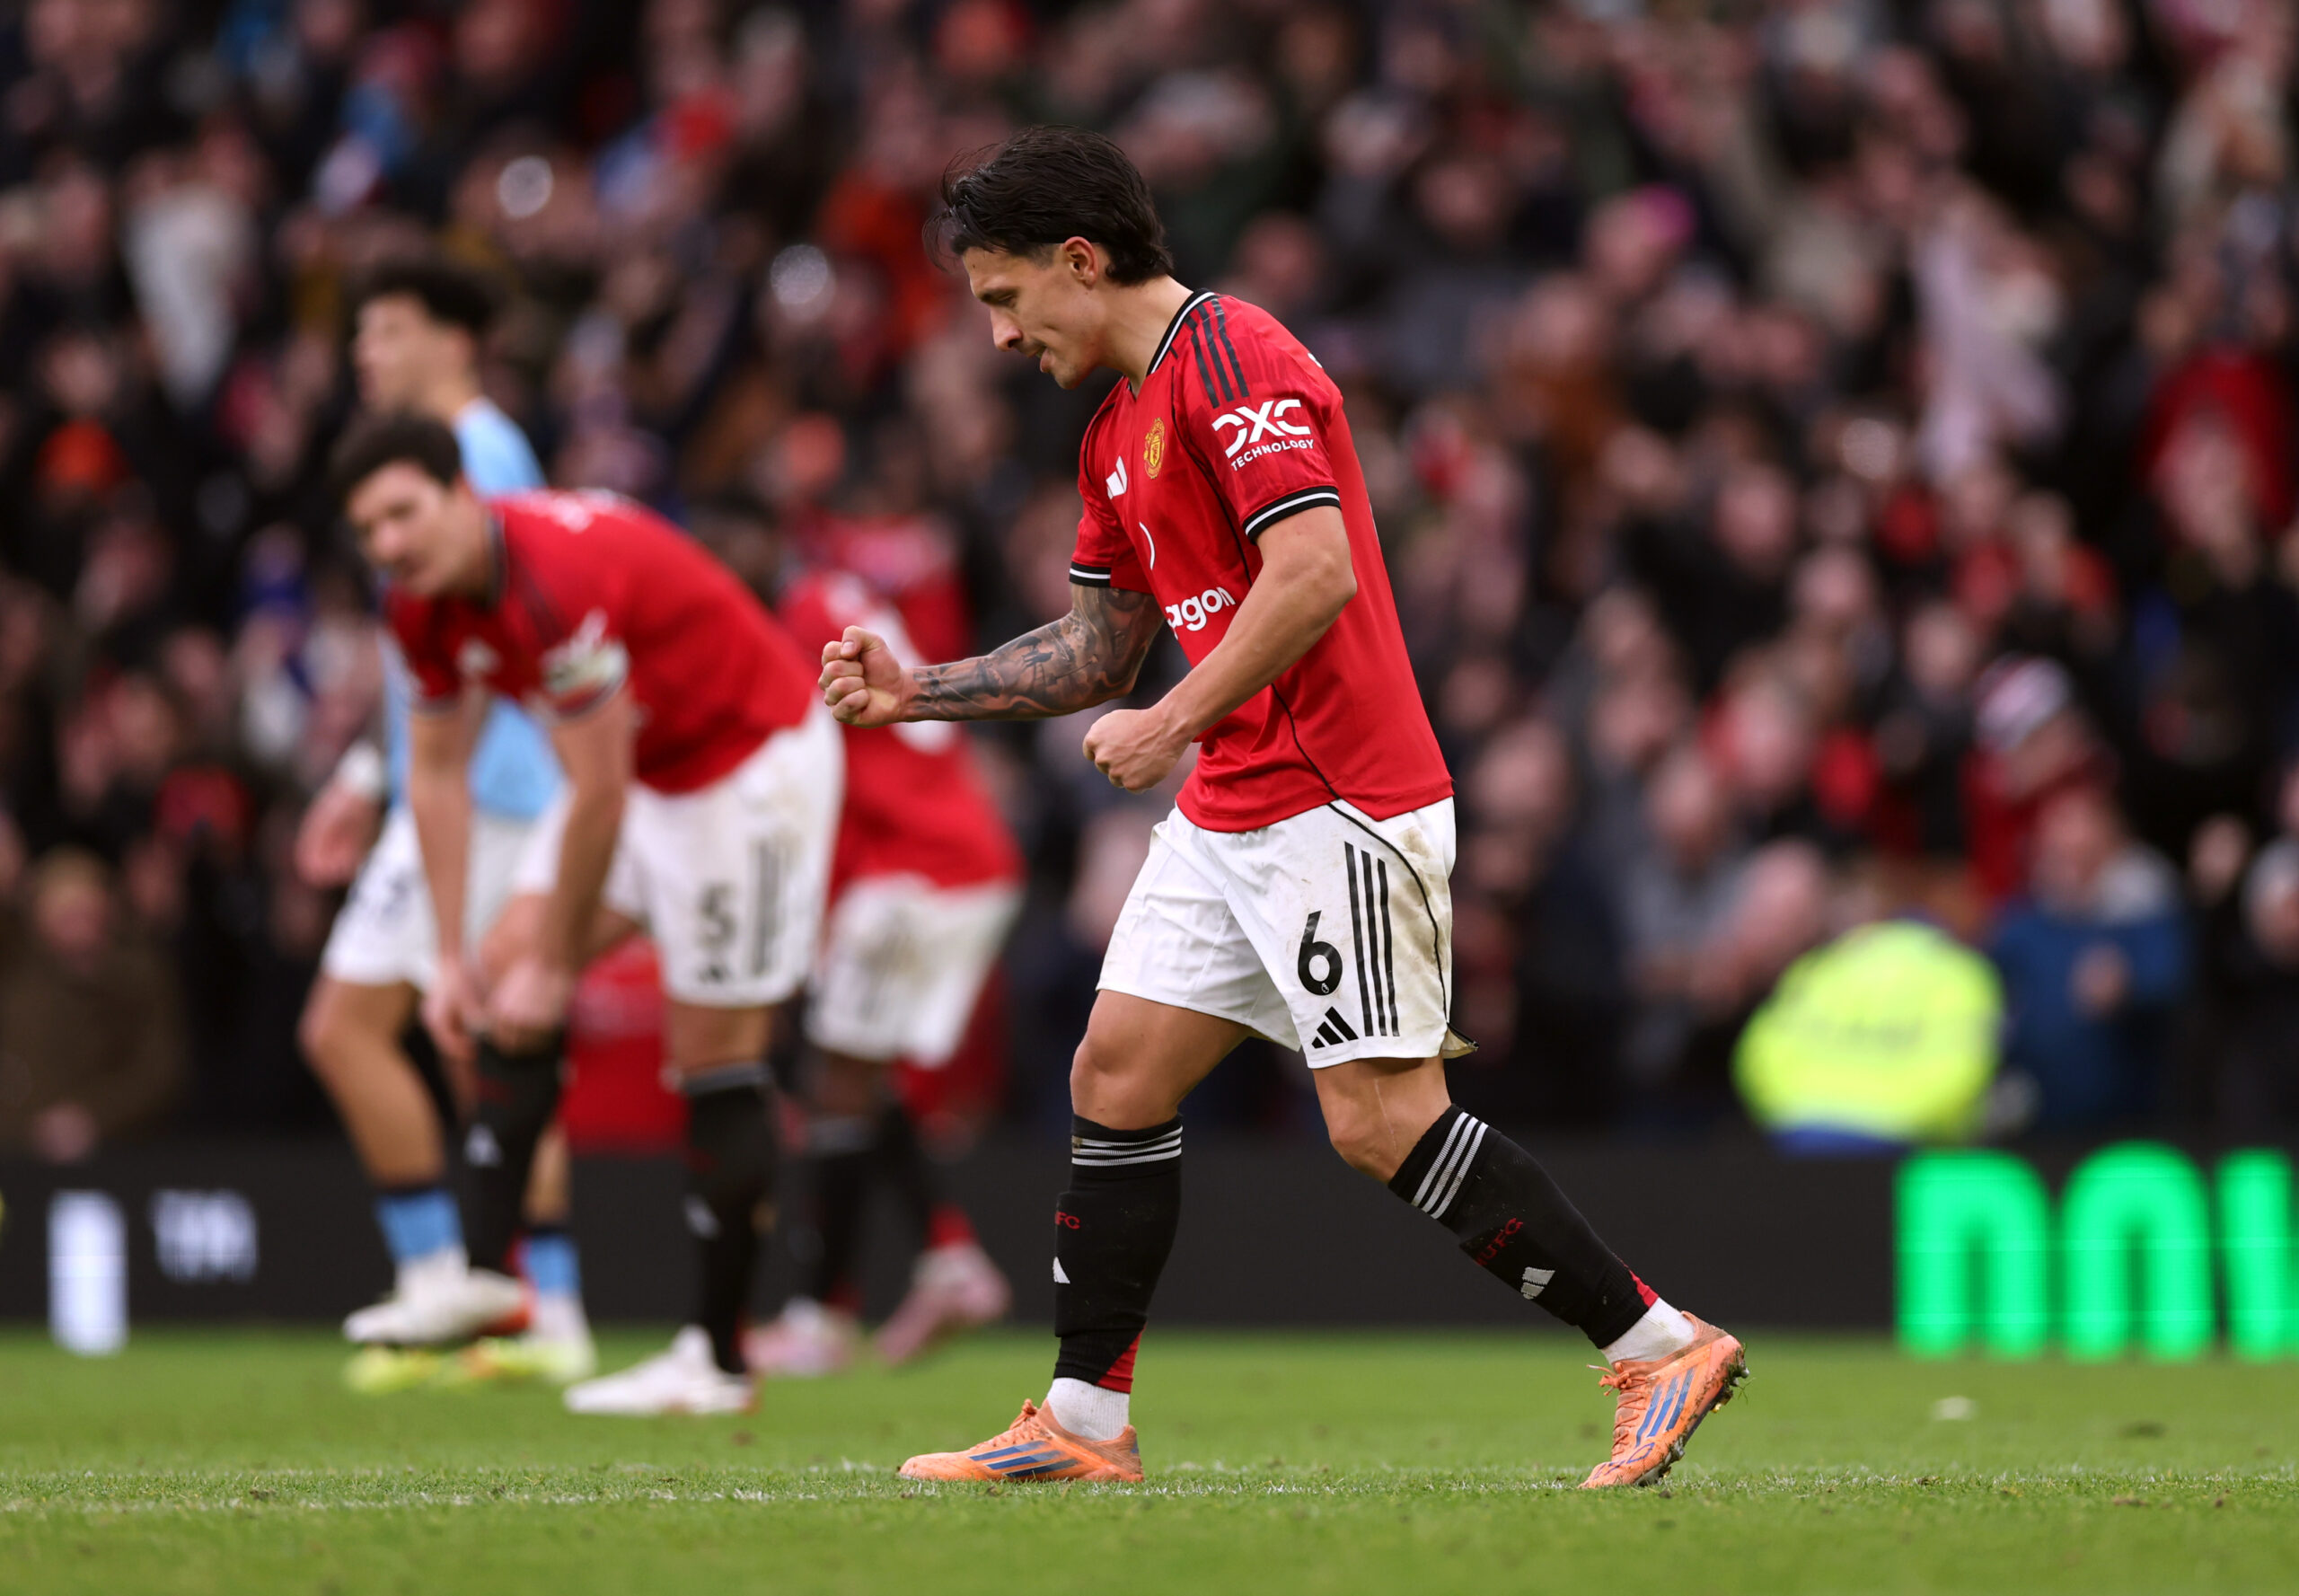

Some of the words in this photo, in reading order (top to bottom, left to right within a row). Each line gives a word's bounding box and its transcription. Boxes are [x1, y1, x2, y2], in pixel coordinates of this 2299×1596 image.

[1230, 439, 1314, 472] TECHNOLOGY
[699, 882, 736, 949] 5
[1298, 910, 1343, 996] 6
